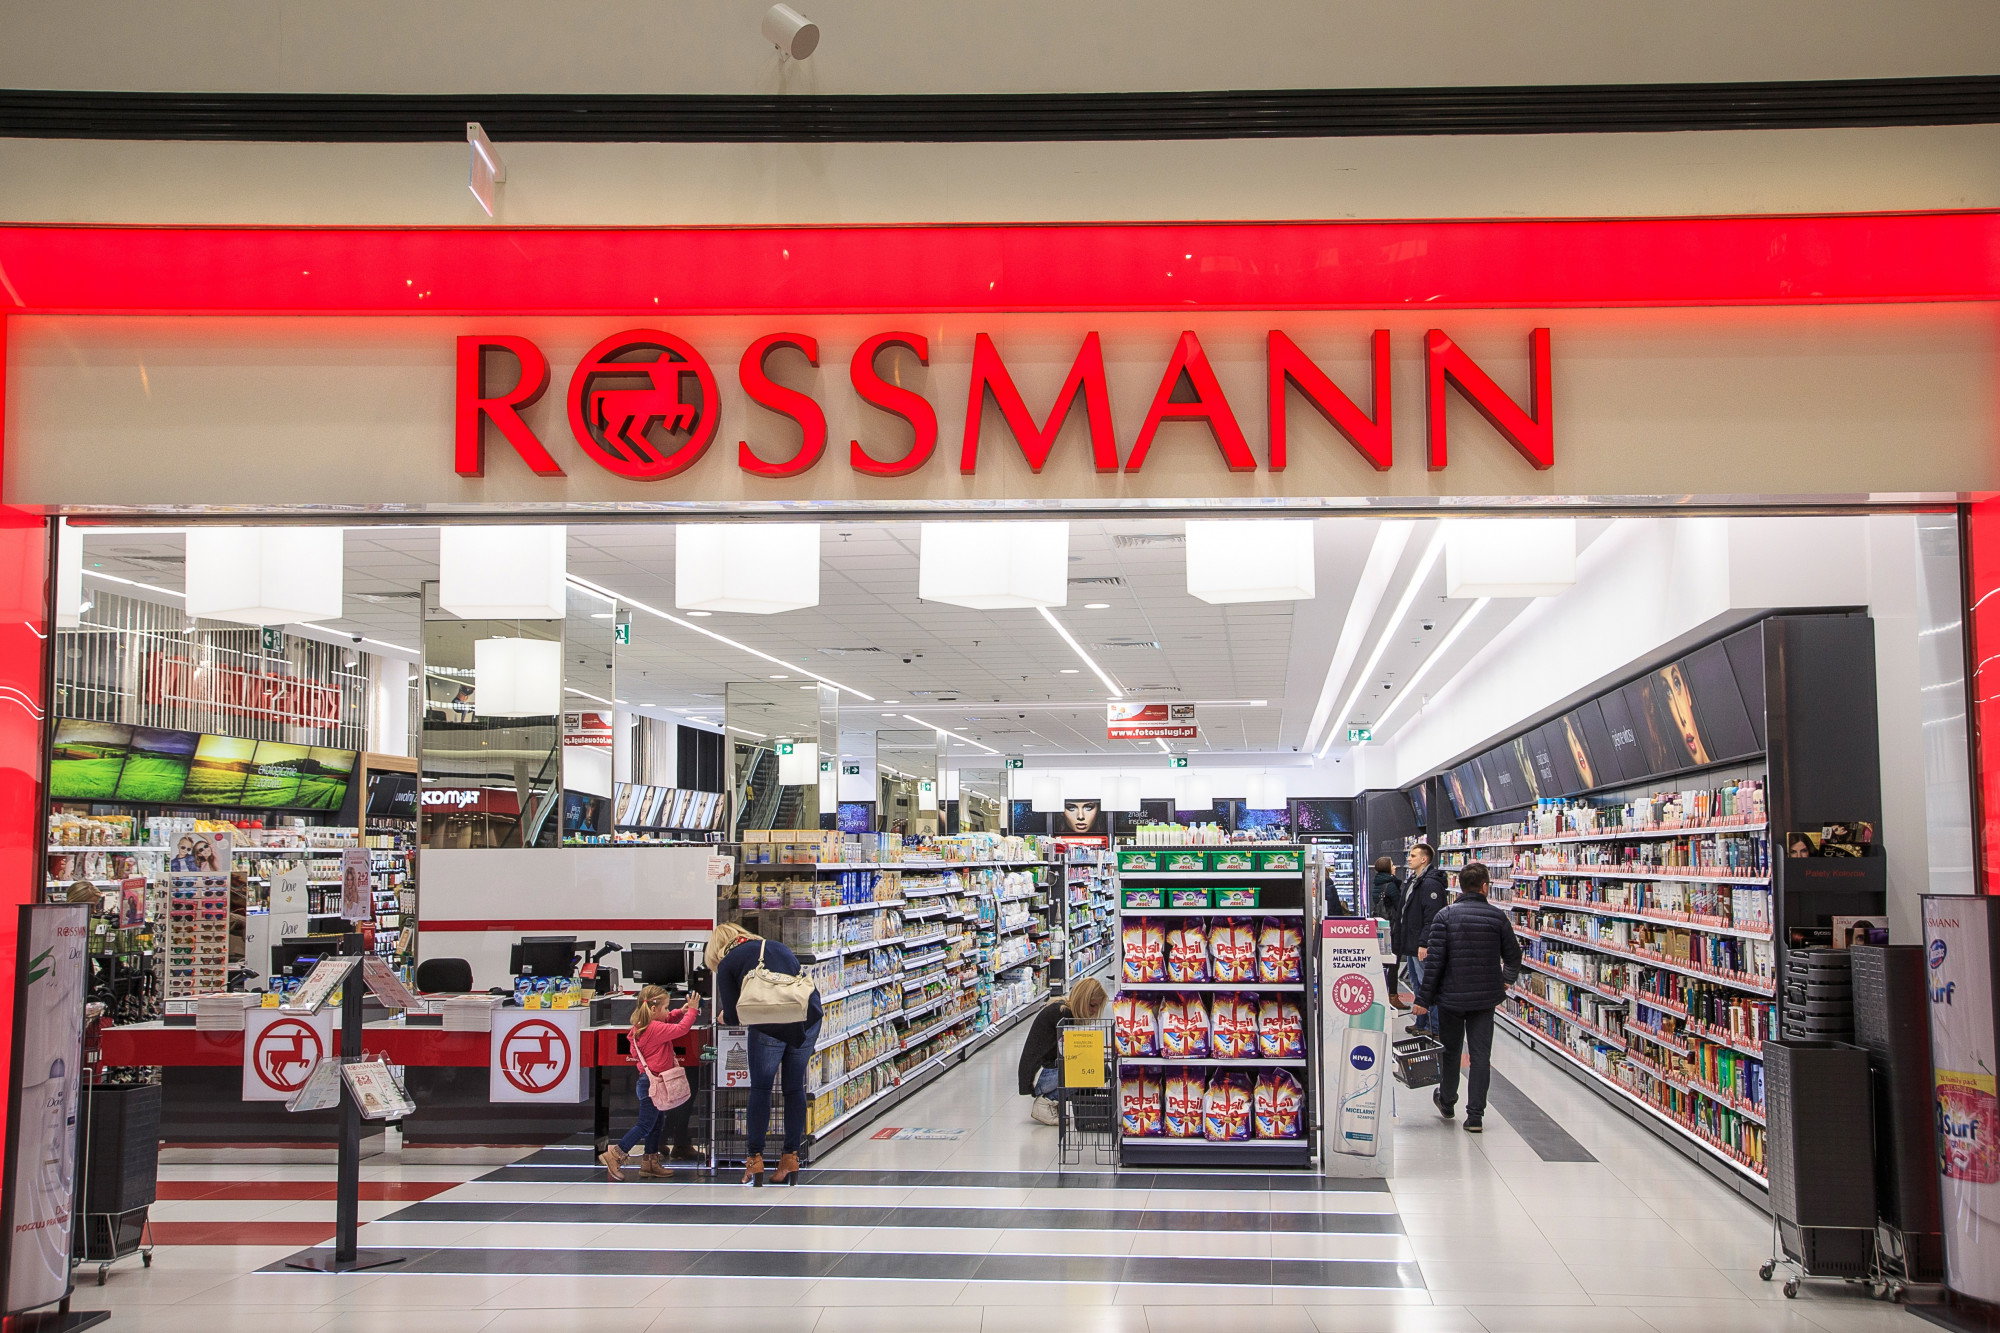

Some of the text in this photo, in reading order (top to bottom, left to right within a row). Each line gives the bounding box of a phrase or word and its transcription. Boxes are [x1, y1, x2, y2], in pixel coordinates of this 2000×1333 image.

[455, 328, 1556, 480] ROSSMANN
[1111, 728, 1194, 737] www.fotouslugi.pl
[281, 879, 297, 892] Dove
[281, 921, 298, 936] Dove
[1330, 924, 1370, 934] NOWOŚĆ
[1340, 983, 1367, 1004] 0%
[1115, 1014, 1149, 1028] Persil
[1263, 1015, 1299, 1027] Persil
[1962, 1079, 1978, 1087] pack
[1124, 1092, 1159, 1106] Persil
[1943, 1113, 1980, 1141] Surf
[15, 1221, 46, 1233] POCZUJ
